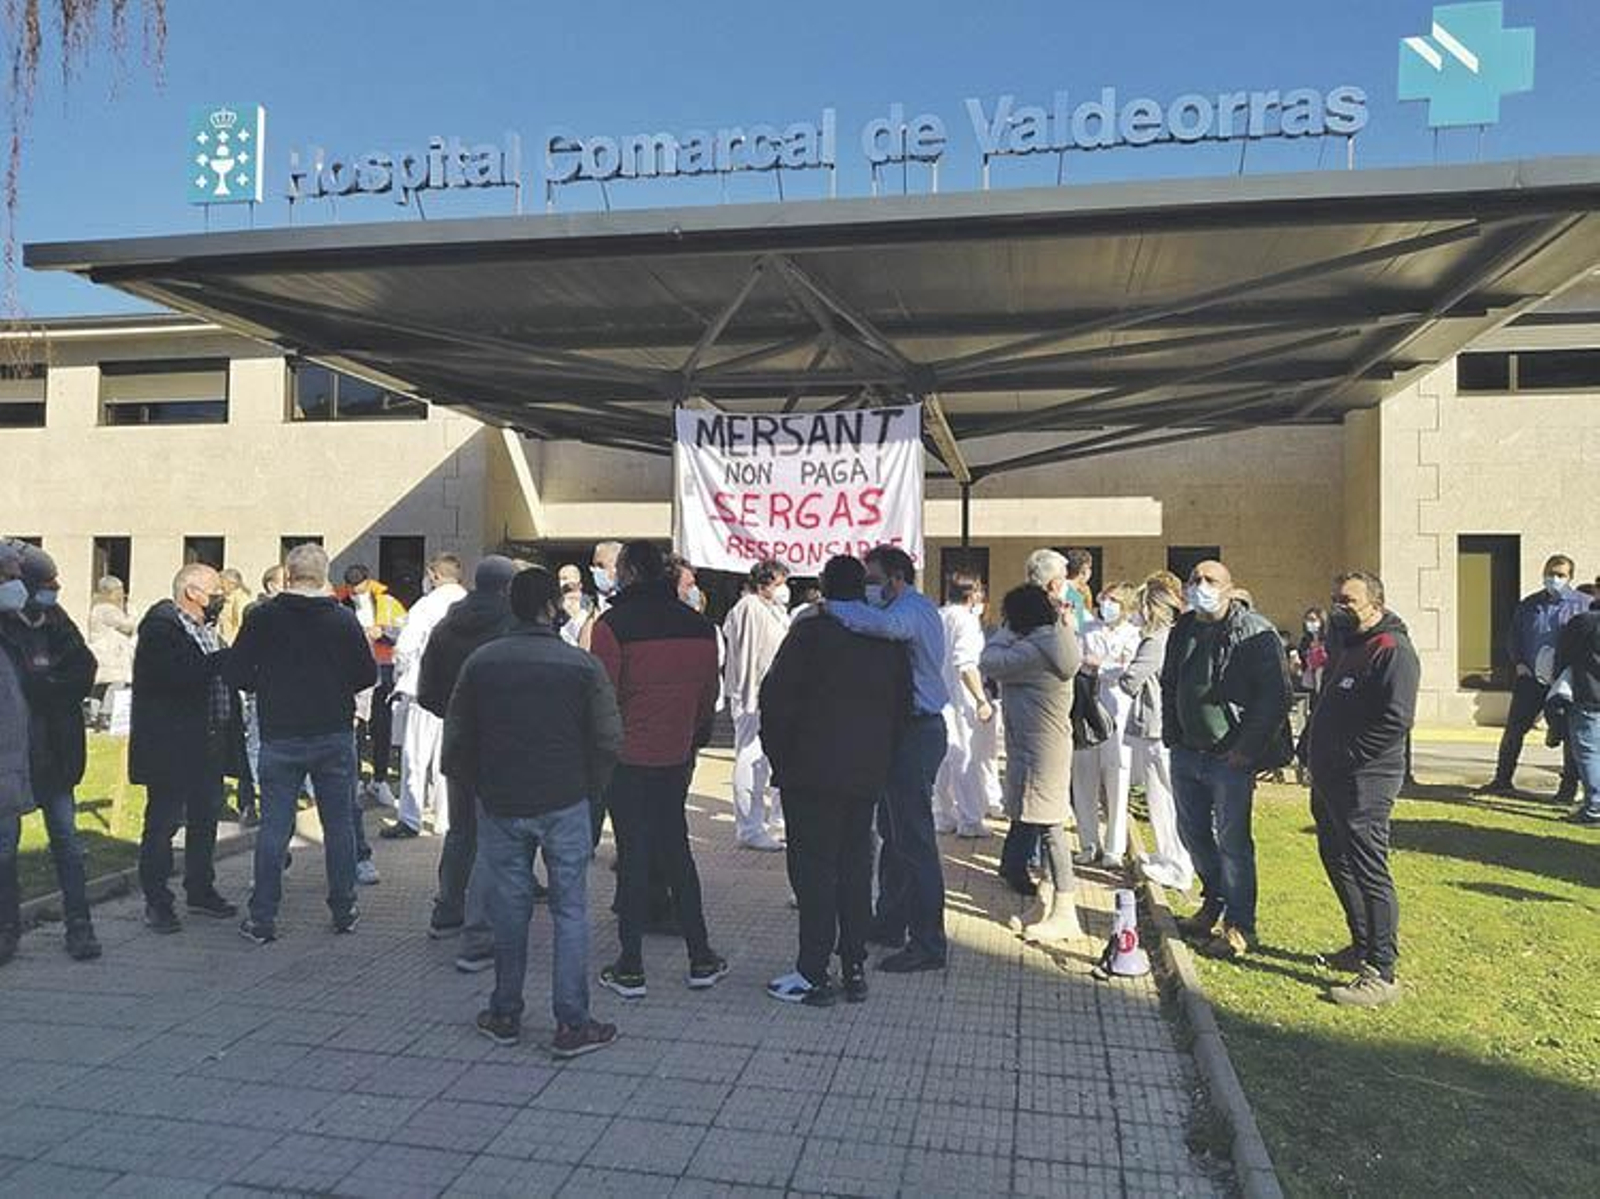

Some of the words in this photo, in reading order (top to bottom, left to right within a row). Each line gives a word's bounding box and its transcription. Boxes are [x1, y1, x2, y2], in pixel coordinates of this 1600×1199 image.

[288, 133, 521, 204] Hospital
[546, 108, 836, 184] Comarcal
[862, 103, 947, 165] de
[966, 86, 1369, 156] Valdeorras
[696, 409, 905, 457] MERSANT
[725, 461, 773, 485] NON
[709, 487, 885, 530] SERGAS
